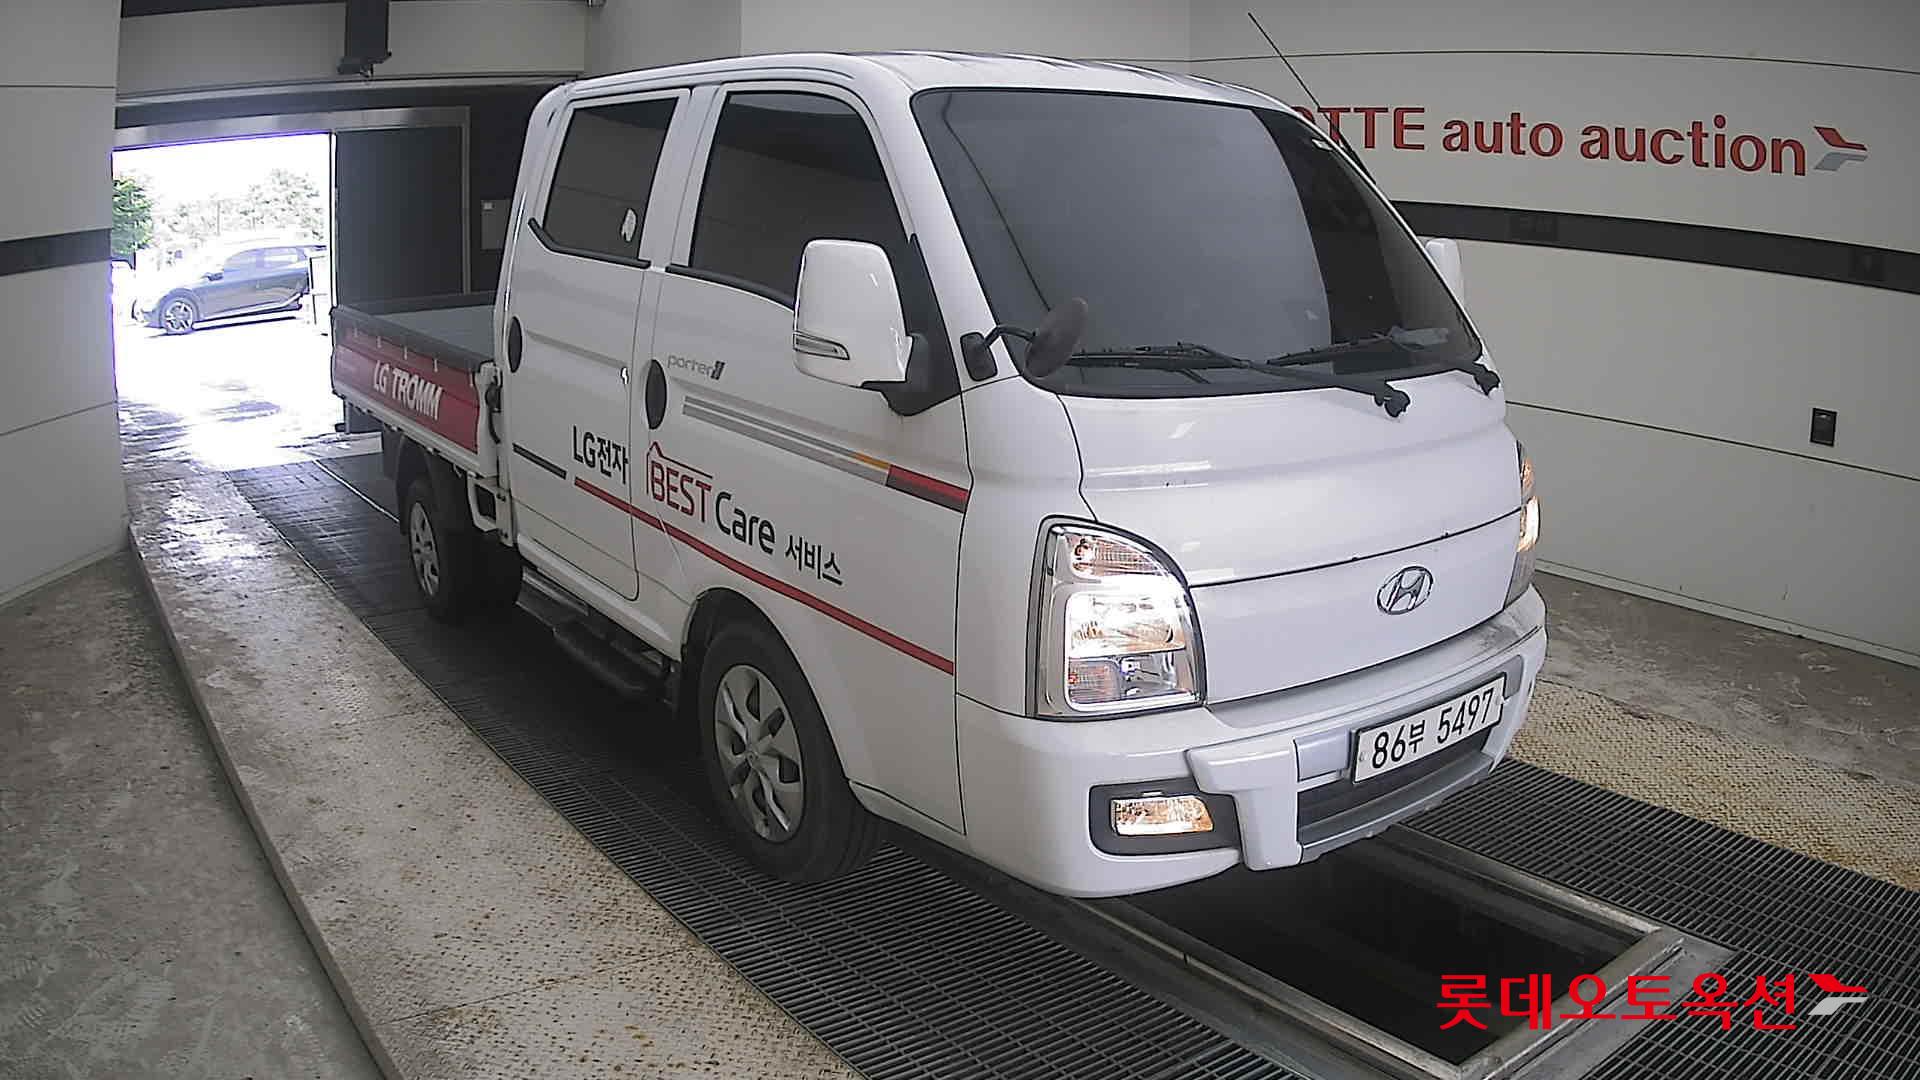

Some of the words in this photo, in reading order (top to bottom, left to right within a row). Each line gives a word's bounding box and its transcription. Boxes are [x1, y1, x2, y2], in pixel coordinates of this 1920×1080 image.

[1442, 112, 1563, 157] auto
[1580, 114, 1806, 176] auction
[373, 360, 390, 393] LG
[392, 368, 443, 421] TROMM
[573, 425, 629, 484] LG전자
[651, 460, 712, 523] BEST
[715, 491, 776, 555] Care
[785, 535, 843, 586] 서비스
[1372, 719, 1426, 768] 86부
[1437, 688, 1495, 744] 5497
